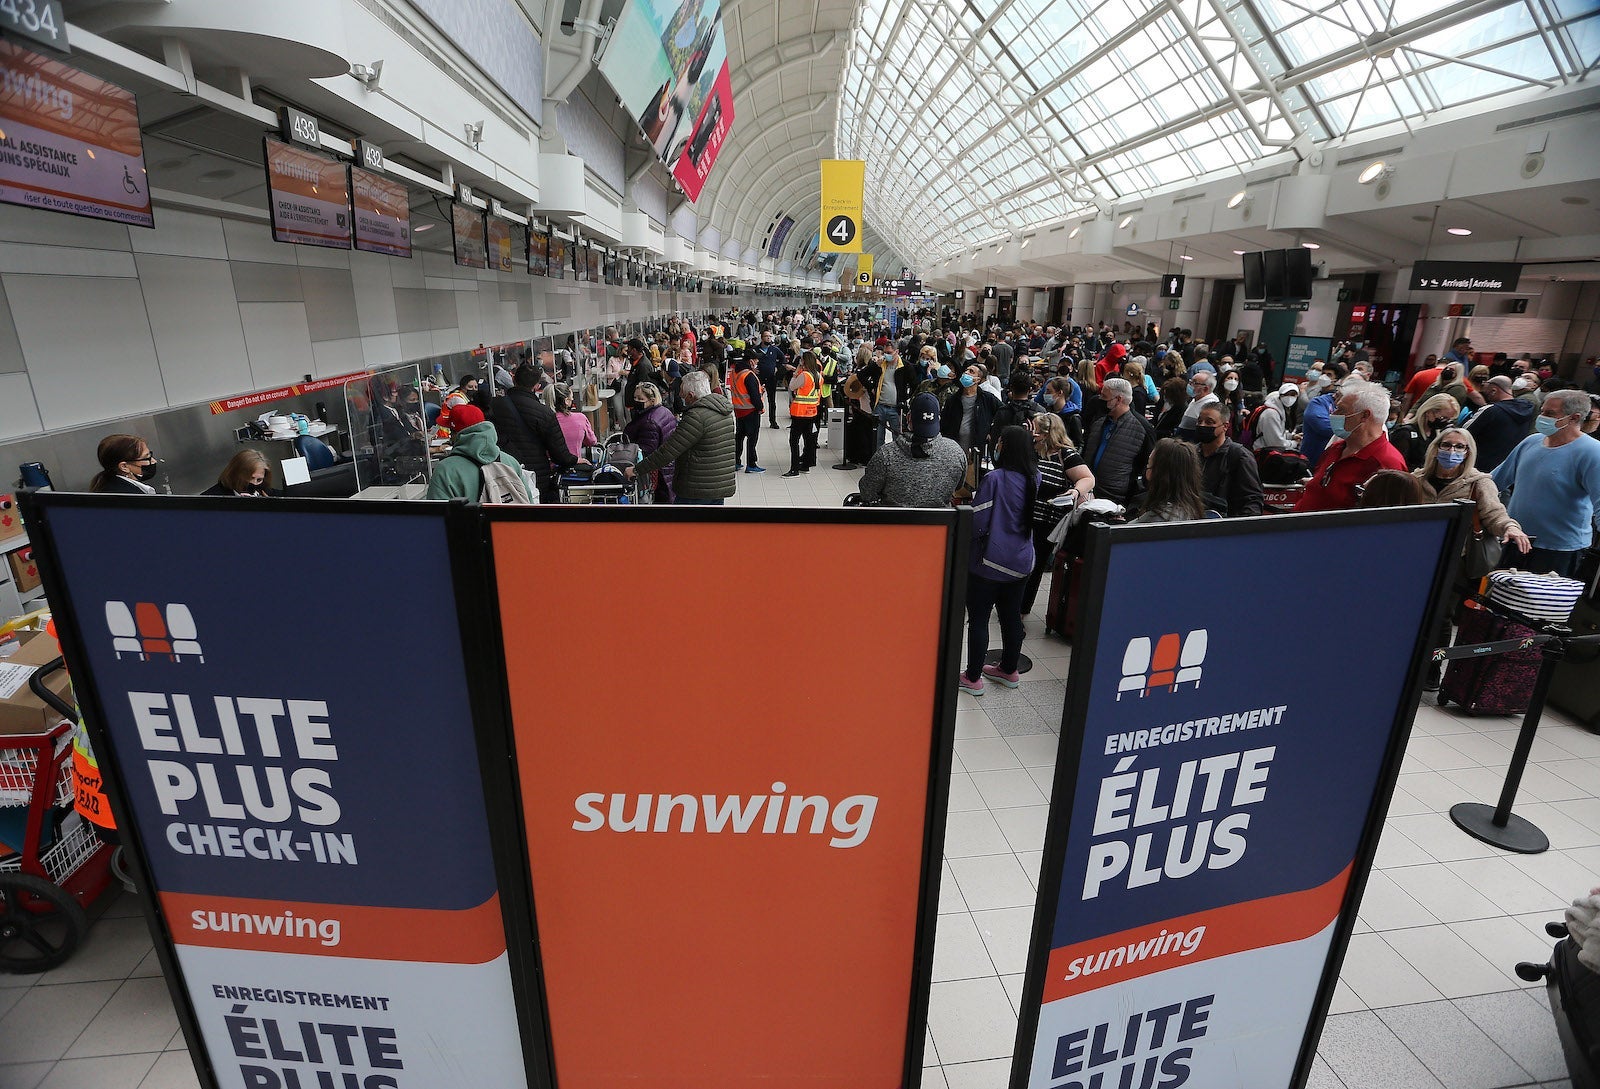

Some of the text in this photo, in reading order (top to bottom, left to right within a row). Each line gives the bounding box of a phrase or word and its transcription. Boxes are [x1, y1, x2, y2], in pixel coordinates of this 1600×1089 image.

[294, 115, 317, 141] 433
[20, 140, 78, 165] ASSISTANCE
[23, 156, 71, 178] SPÉCIAUX
[365, 146, 382, 168] 432
[274, 159, 319, 187] sunwing
[42, 195, 52, 206] de
[53, 197, 75, 210] toute
[74, 201, 103, 215] question
[104, 207, 112, 217] ou
[832, 219, 849, 241] 4
[861, 273, 868, 282] 3
[227, 398, 245, 409] Danger!
[252, 395, 260, 403] not
[272, 389, 289, 399] conveyor
[128, 691, 338, 760] ELITE
[1104, 705, 1287, 755] ENREGISTREMENT
[147, 759, 341, 826] PLUS
[1092, 746, 1276, 836] ÉLITE
[572, 781, 879, 849] sunwing
[166, 822, 358, 865] CHECK-IN
[1081, 813, 1251, 901] PLUS
[191, 909, 341, 947] sunwing
[1064, 925, 1206, 981] sunwing
[212, 984, 390, 1011] ENREGISTREMENT
[224, 1003, 404, 1070] ÉLITE
[1051, 994, 1215, 1080] ELITE
